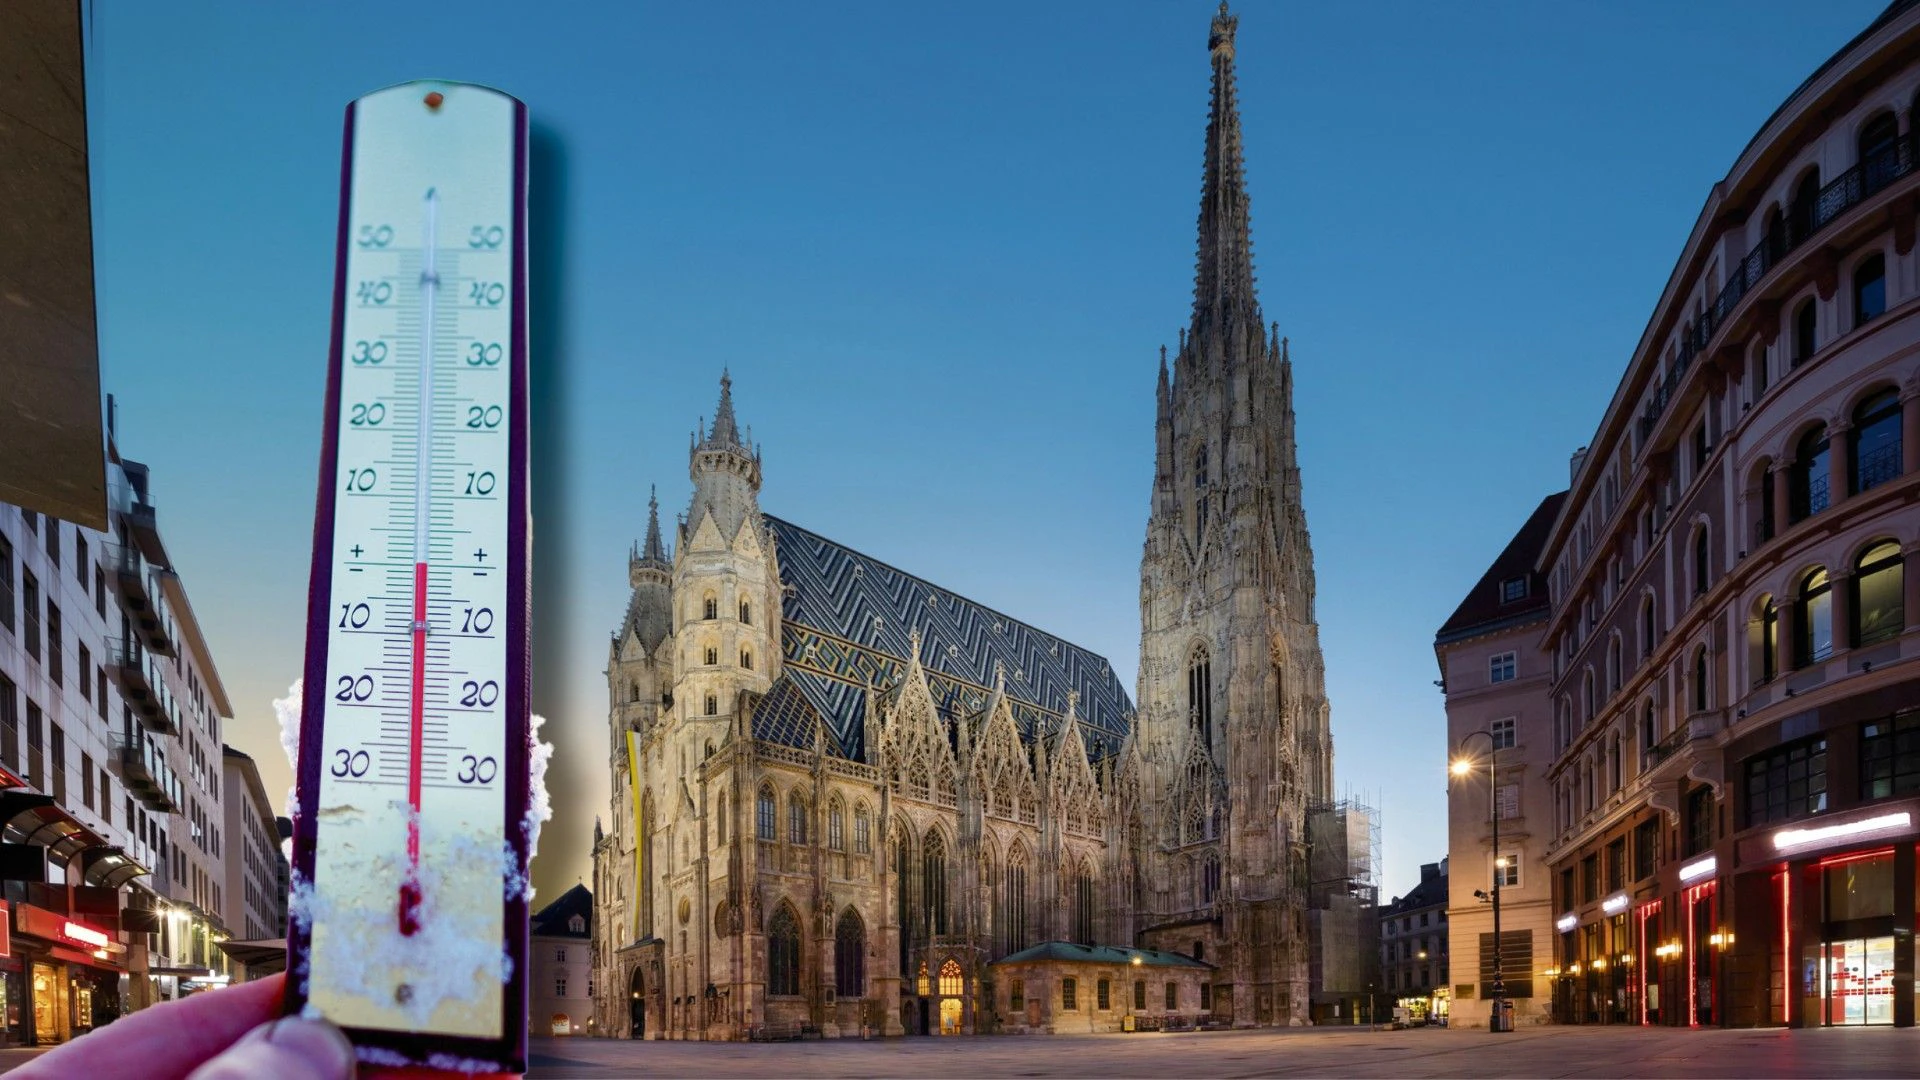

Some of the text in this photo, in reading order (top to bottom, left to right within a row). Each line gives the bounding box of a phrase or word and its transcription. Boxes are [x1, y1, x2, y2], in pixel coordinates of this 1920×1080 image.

[356, 225, 394, 248] 50
[467, 225, 504, 249] 50
[357, 281, 392, 305] 40
[469, 282, 505, 306] 40
[351, 341, 388, 365] 30
[466, 342, 502, 366] 30
[349, 402, 386, 426] 20
[467, 405, 502, 428] 20
[346, 468, 377, 492] 10
[465, 471, 496, 495] 10
[338, 602, 370, 629] 10
[461, 607, 494, 633] 10
[335, 674, 374, 702] 20
[460, 680, 499, 707] 20
[331, 748, 370, 778] 30
[458, 755, 497, 784] 30
